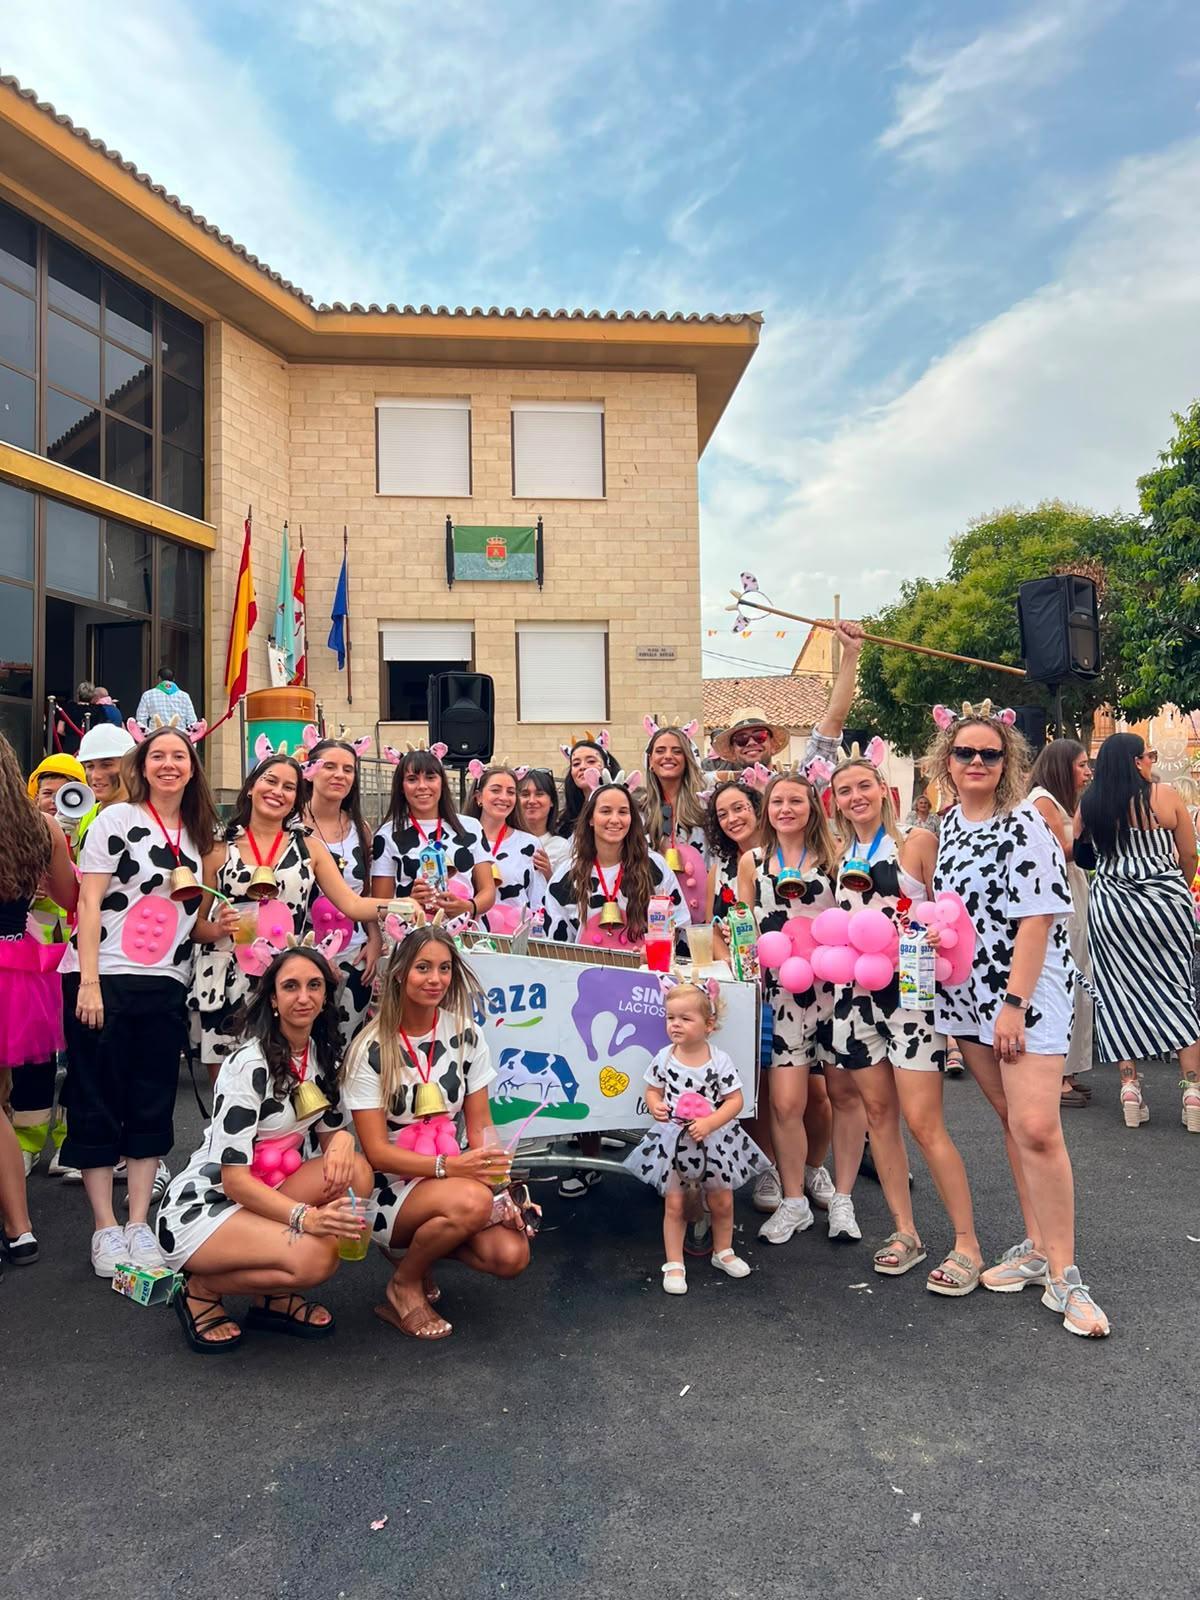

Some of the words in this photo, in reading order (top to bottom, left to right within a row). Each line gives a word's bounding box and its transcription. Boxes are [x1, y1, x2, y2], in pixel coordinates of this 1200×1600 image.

[736, 924, 753, 936] gaza
[900, 943, 917, 955] gaza
[631, 985, 665, 1006] SIN
[618, 999, 667, 1018] LACTOS
